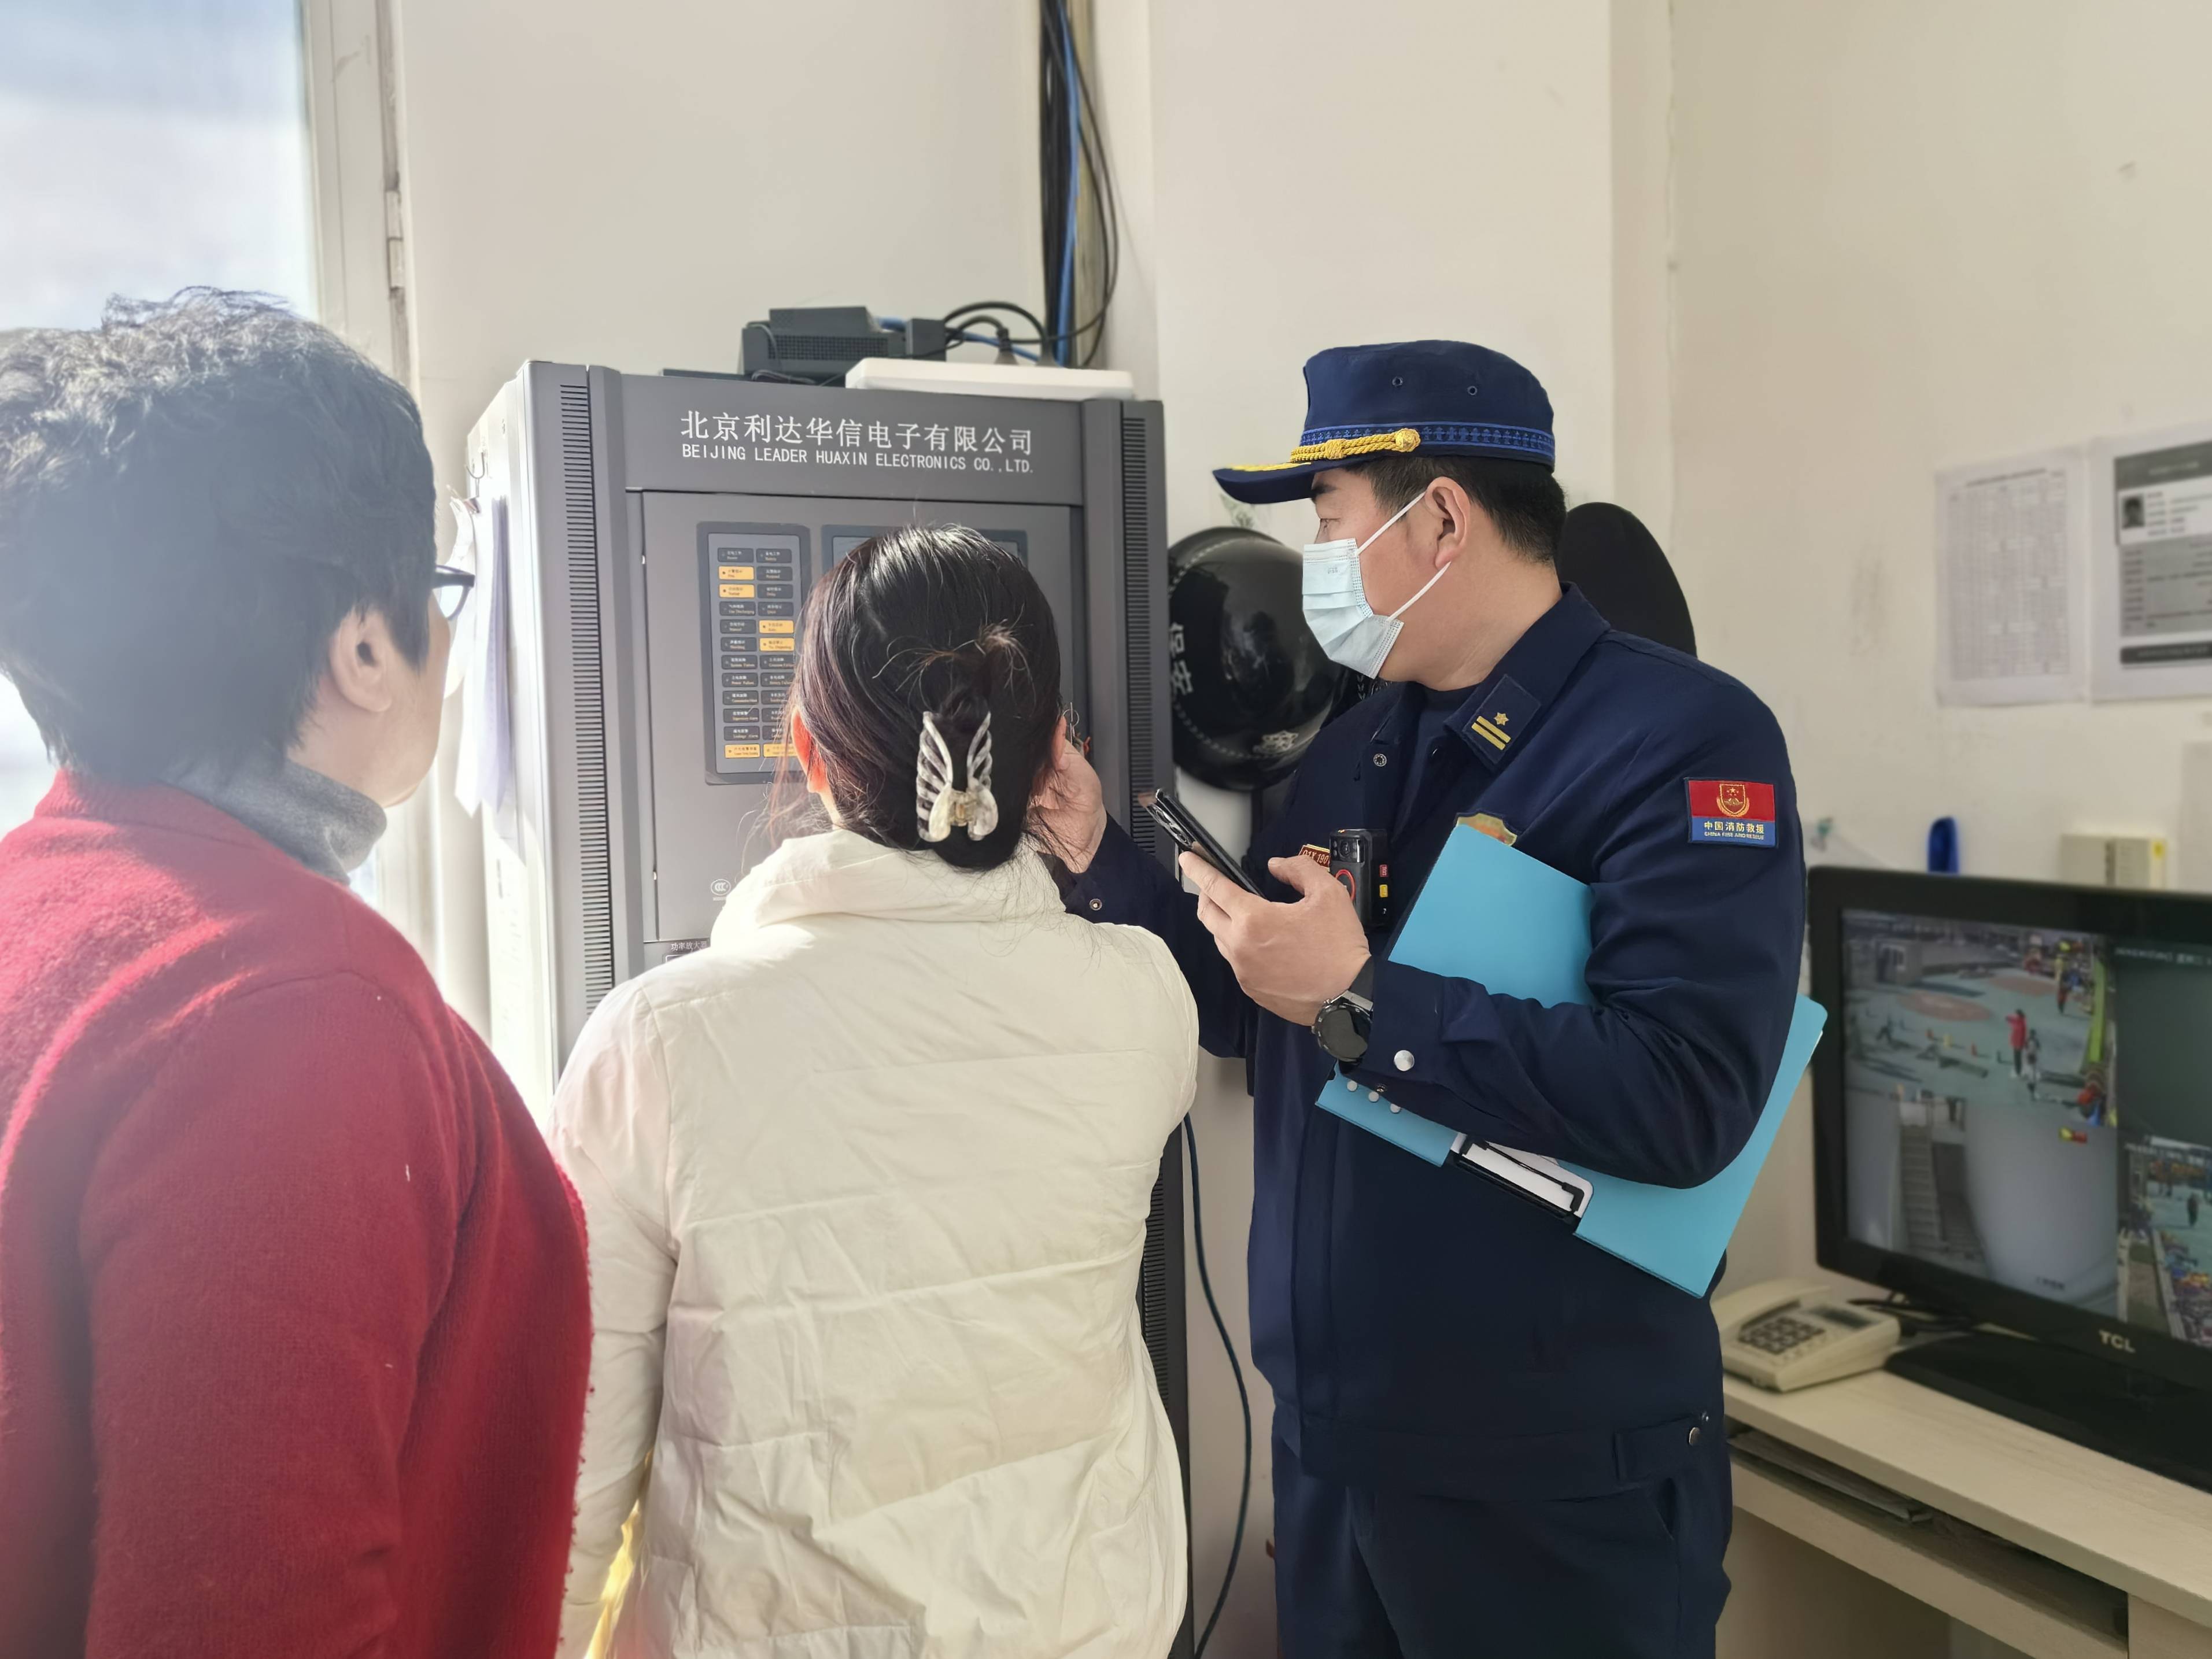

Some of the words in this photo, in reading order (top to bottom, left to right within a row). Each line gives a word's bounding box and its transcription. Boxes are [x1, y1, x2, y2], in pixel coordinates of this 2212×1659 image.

[681, 410, 1032, 456] 北京利达华信电子有限公司
[682, 444, 746, 461] BEIJING
[754, 447, 808, 463] LEADER
[815, 450, 867, 466] HUAXIN
[875, 453, 967, 470] ELECTRONICS
[1704, 821, 1764, 834] 中国消防救援
[2098, 1329, 2136, 1353] TCL
